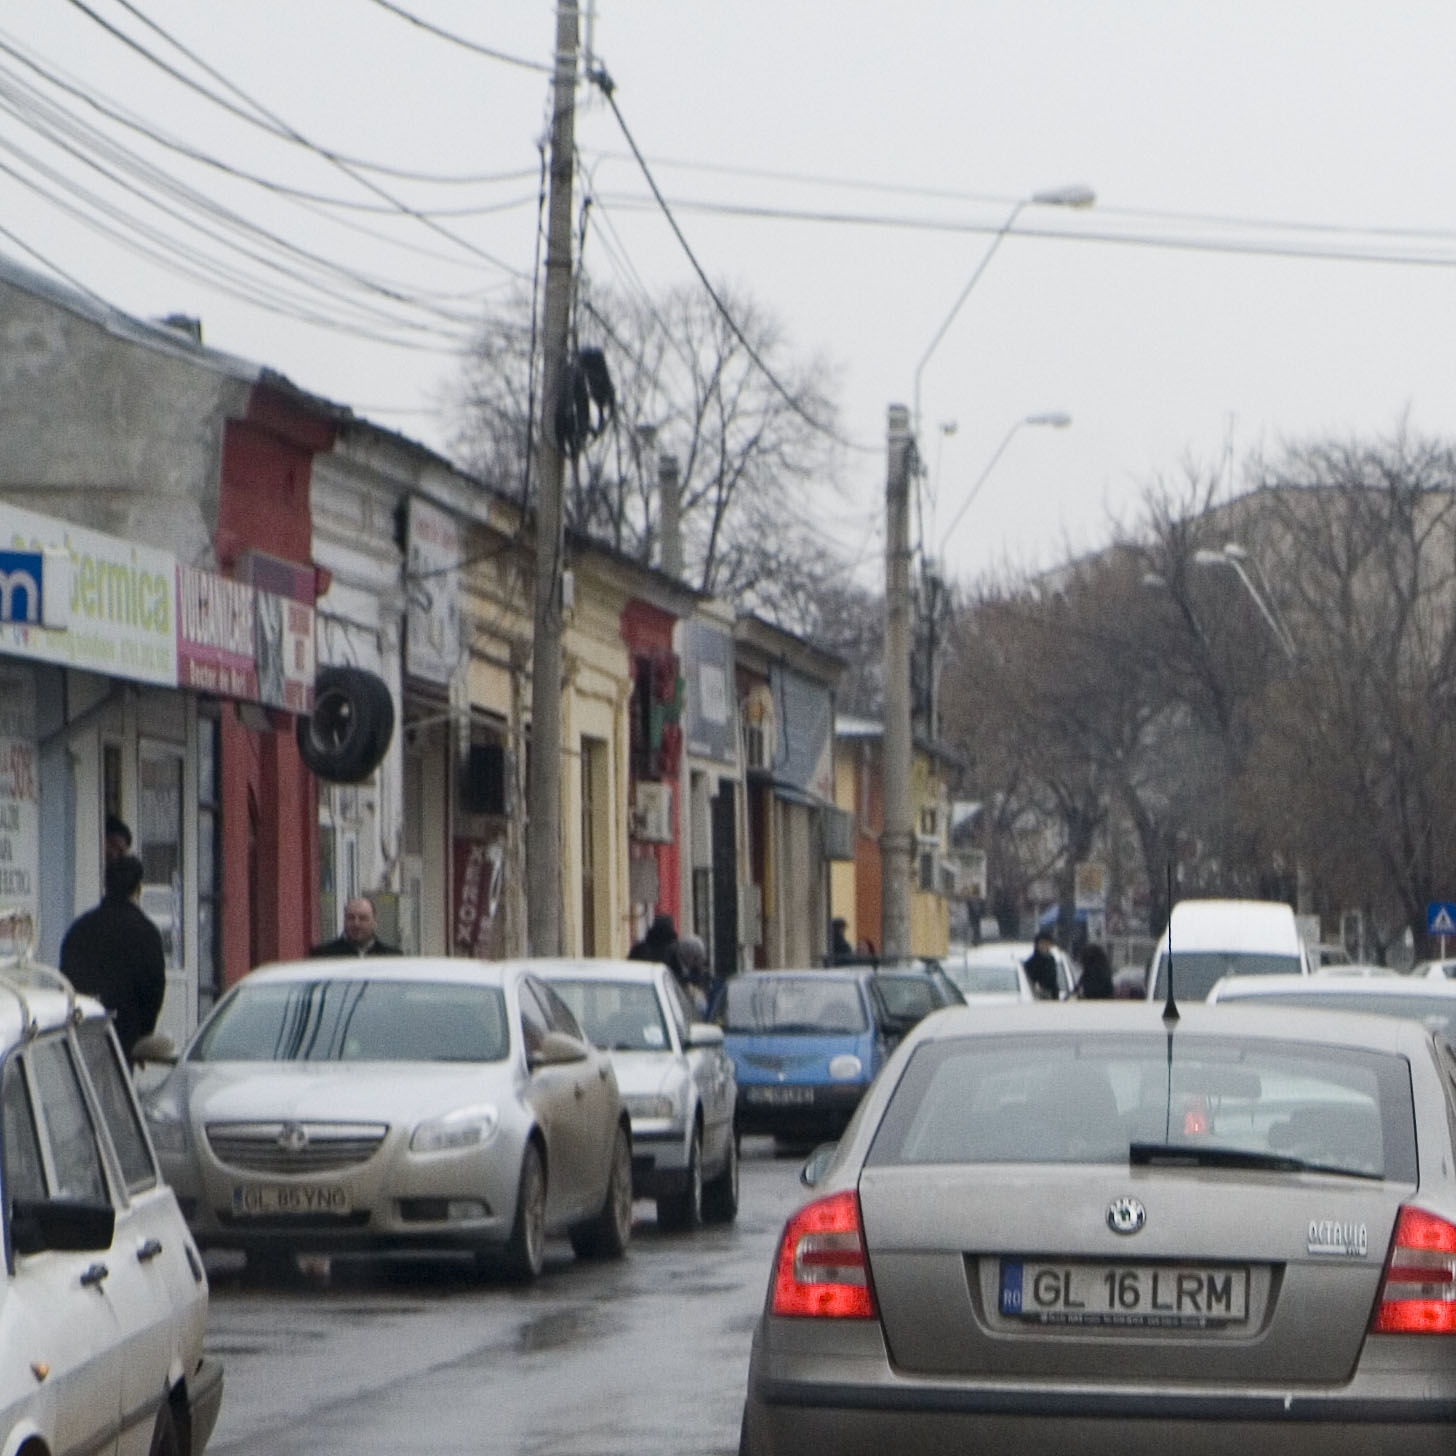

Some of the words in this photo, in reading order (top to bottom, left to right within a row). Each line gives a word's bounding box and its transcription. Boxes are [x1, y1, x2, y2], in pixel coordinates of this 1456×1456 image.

[1308, 1220, 1367, 1249] OCTAVIA
[1003, 1288, 1022, 1307] RO
[1033, 1269, 1085, 1308] GL
[1105, 1270, 1140, 1309] 16
[1152, 1271, 1232, 1314] LRM
